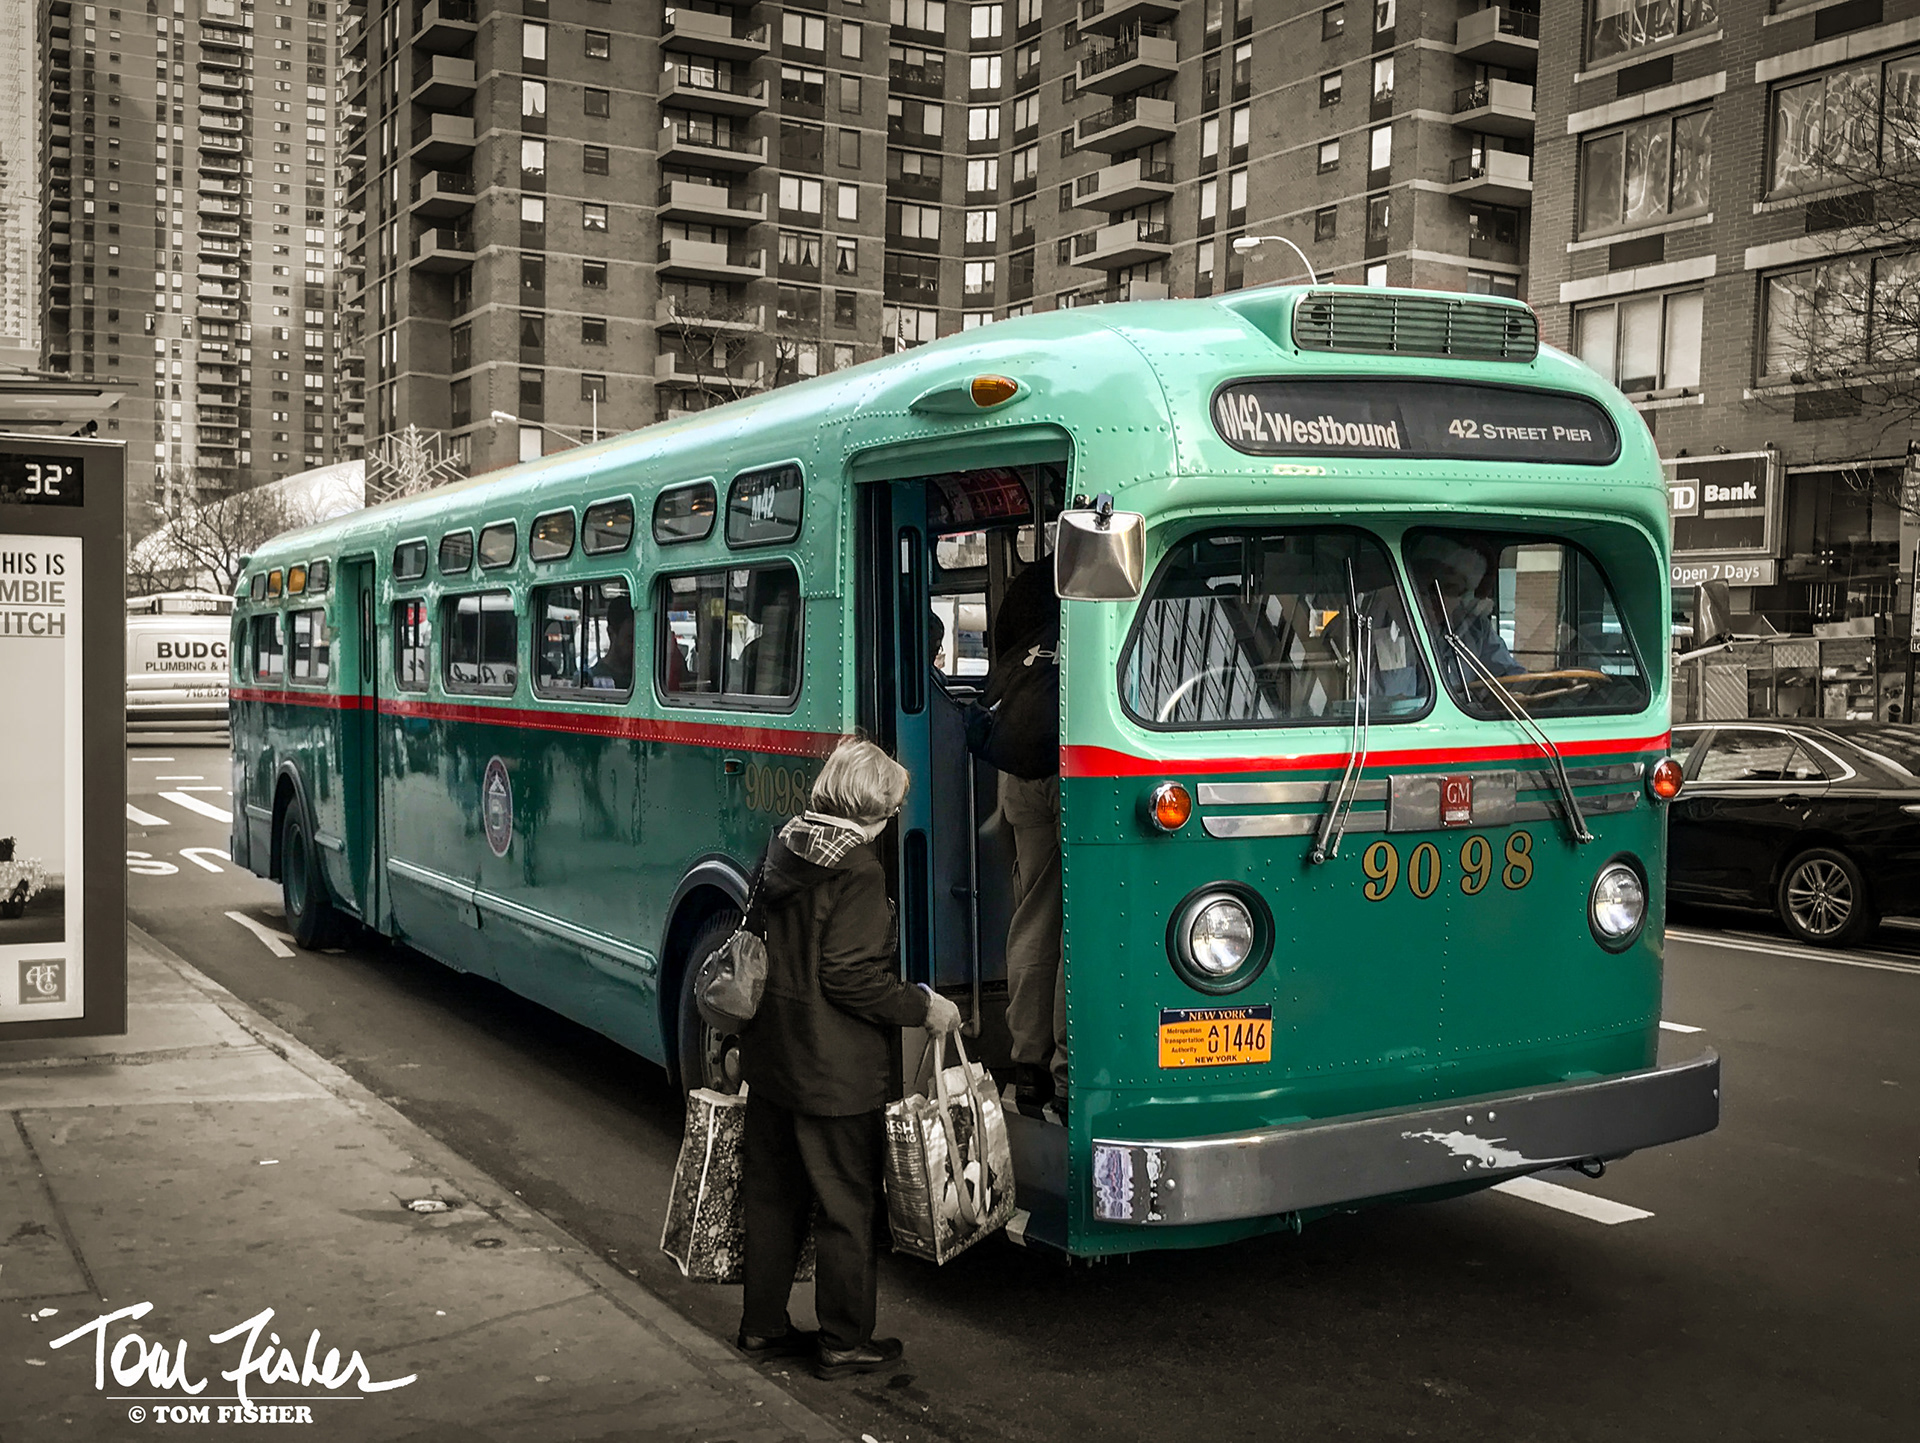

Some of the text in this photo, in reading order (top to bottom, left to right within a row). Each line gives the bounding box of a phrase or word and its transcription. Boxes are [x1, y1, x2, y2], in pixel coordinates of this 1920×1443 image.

[1217, 393, 1401, 450] M42 Westbound
[1448, 419, 1480, 439] 42
[751, 485, 775, 521] M42
[1668, 481, 1757, 510] TD Bank
[0, 552, 65, 576] HIS IS
[1672, 564, 1760, 584] Open 7 Days
[0, 611, 66, 636] ITCH
[157, 642, 227, 658] BUDG
[145, 661, 206, 671] PLUMBING
[210, 662, 218, 671] &
[745, 762, 808, 817] 9098
[1446, 782, 1470, 804] GM
[1361, 830, 1535, 902] 9098
[1188, 1009, 1247, 1021] NEW YORK
[1167, 1027, 1202, 1035] Metropolitan
[1216, 1055, 1238, 1063] YORK
